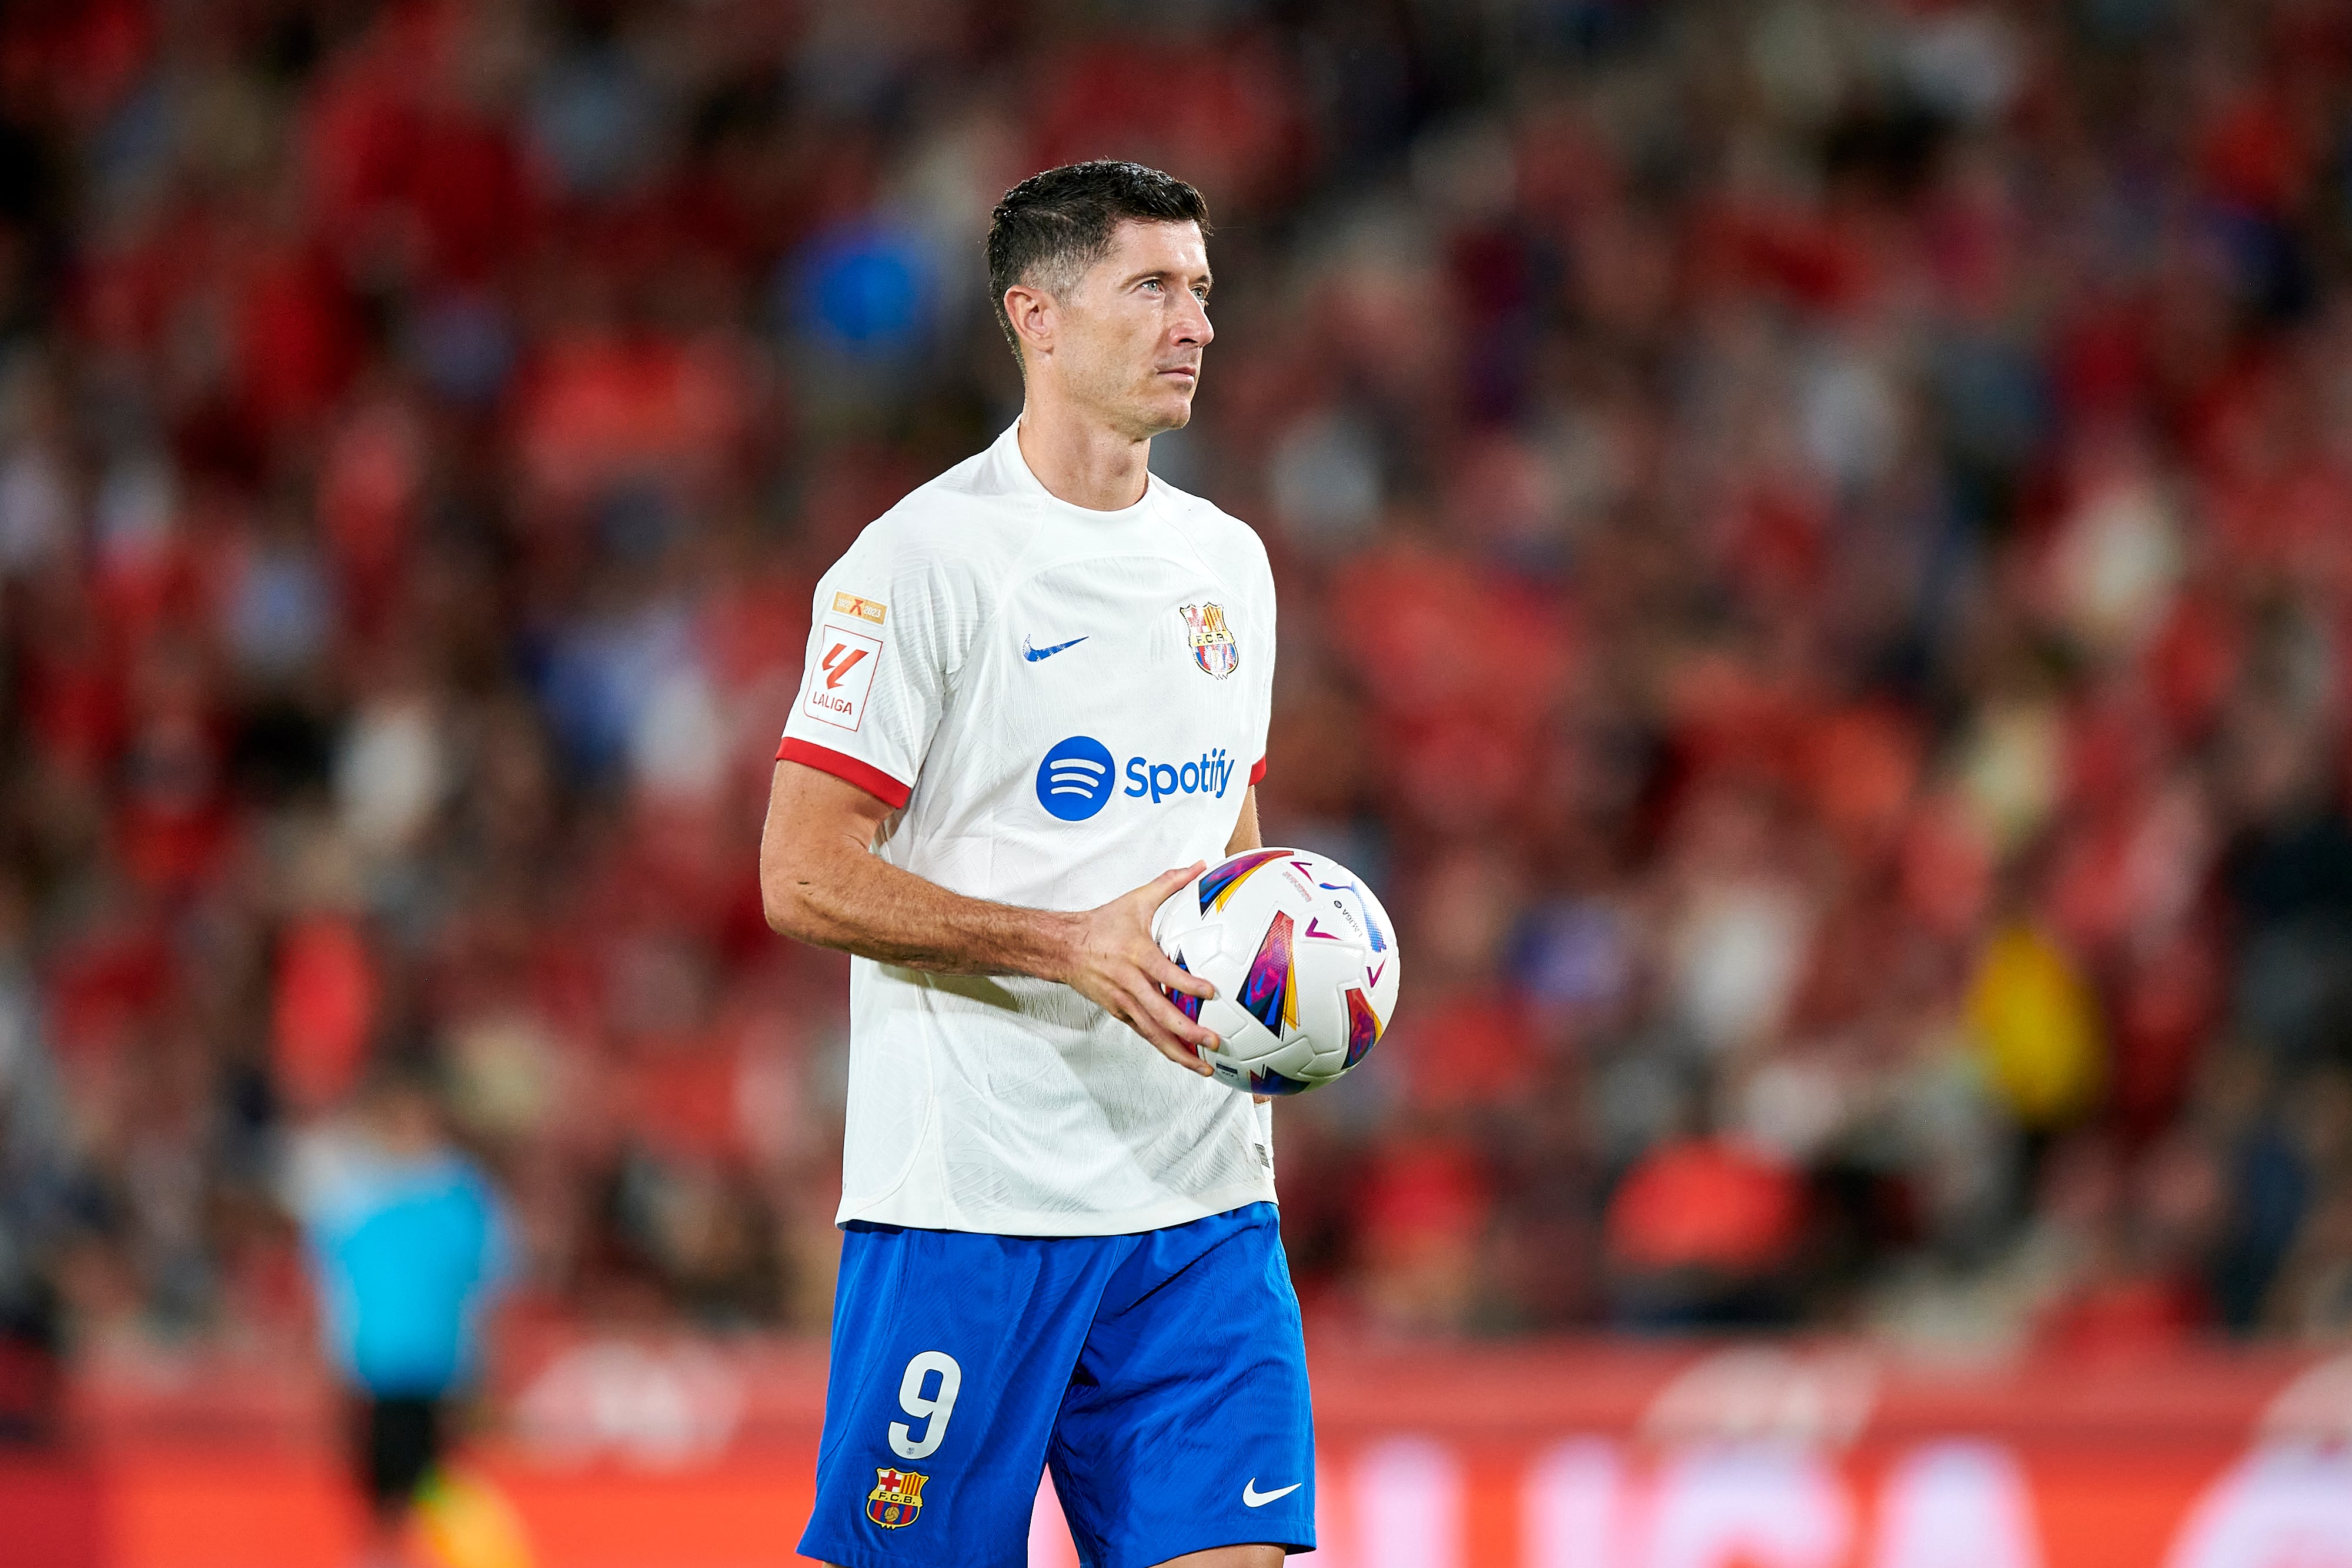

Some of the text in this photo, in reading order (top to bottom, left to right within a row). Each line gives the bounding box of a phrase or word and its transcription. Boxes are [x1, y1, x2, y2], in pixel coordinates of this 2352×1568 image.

[863, 606, 881, 618] 2023
[813, 691, 852, 716] LALIGA
[1124, 747, 1235, 804] Spotify
[887, 1350, 962, 1460] 9
[878, 1492, 916, 1505] F.C.B.
